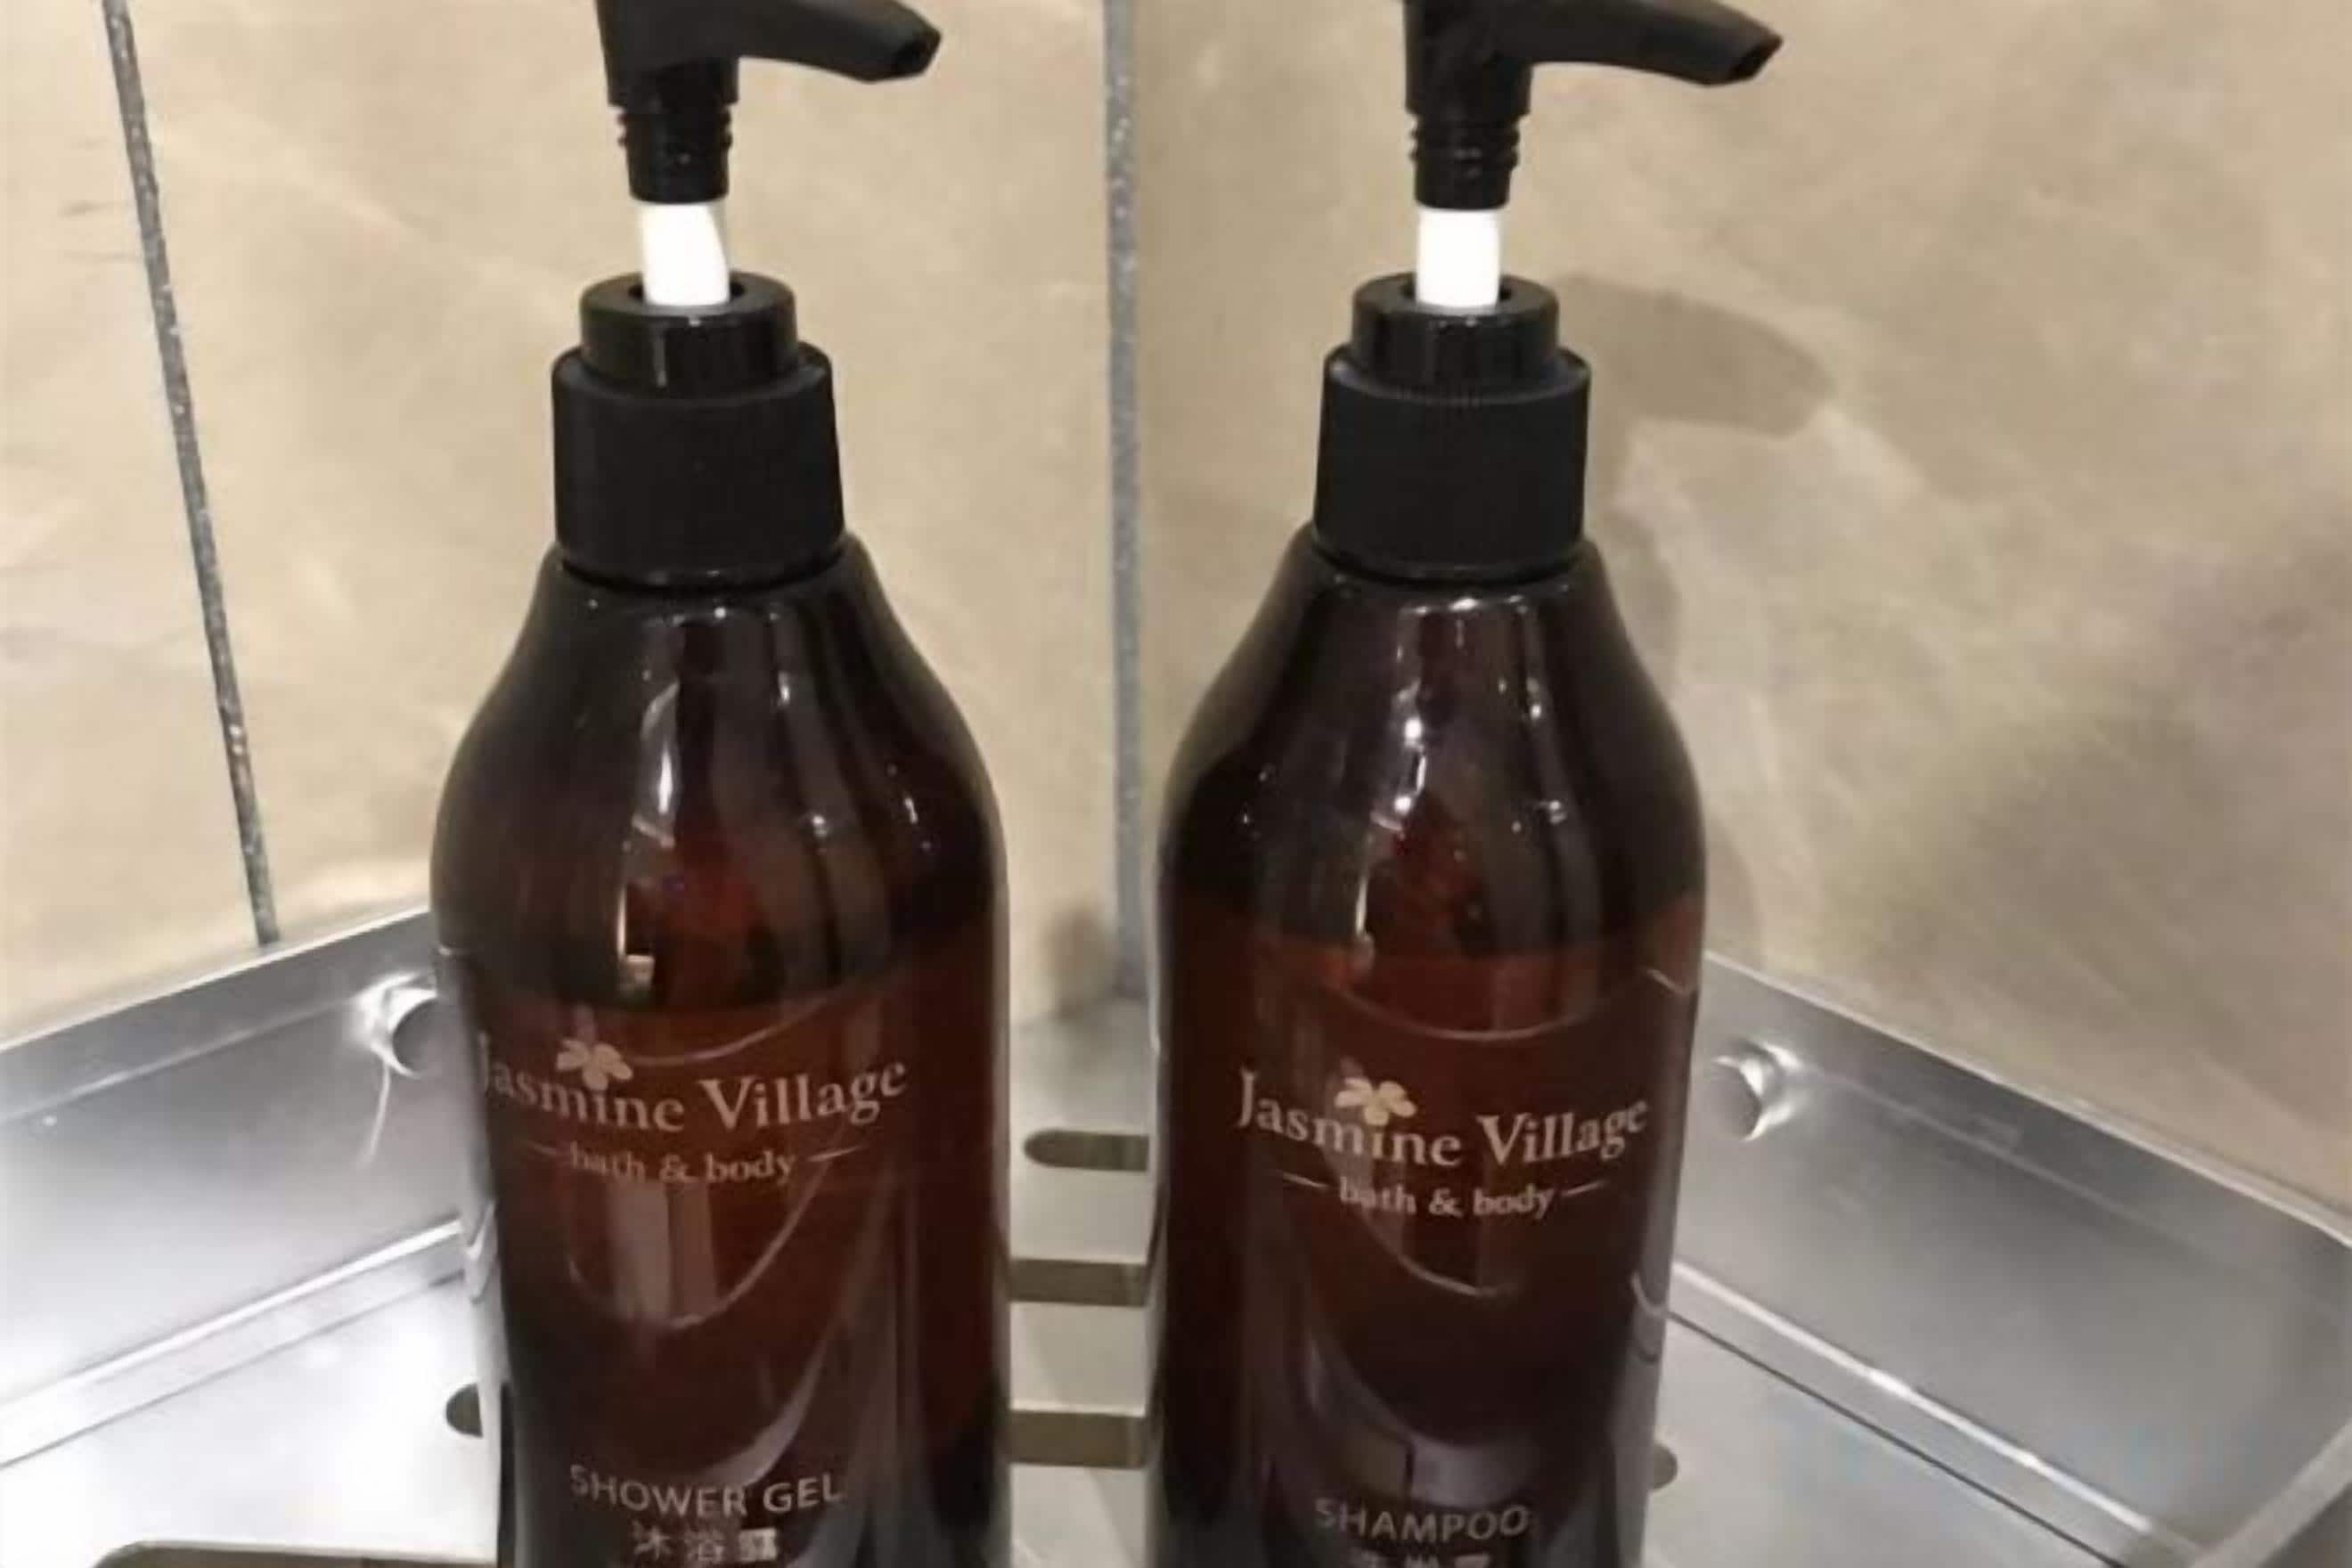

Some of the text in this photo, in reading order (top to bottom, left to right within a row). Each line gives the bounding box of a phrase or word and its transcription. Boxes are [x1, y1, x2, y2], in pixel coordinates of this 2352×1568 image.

[698, 1060, 908, 1127] Village
[1237, 1067, 1649, 1166] Jasmine Village
[568, 1142, 796, 1185] bath & body
[1338, 1175, 1555, 1219] bath & body
[570, 1464, 845, 1516] SHOWER GEL
[1314, 1496, 1531, 1543] SHAMPOO
